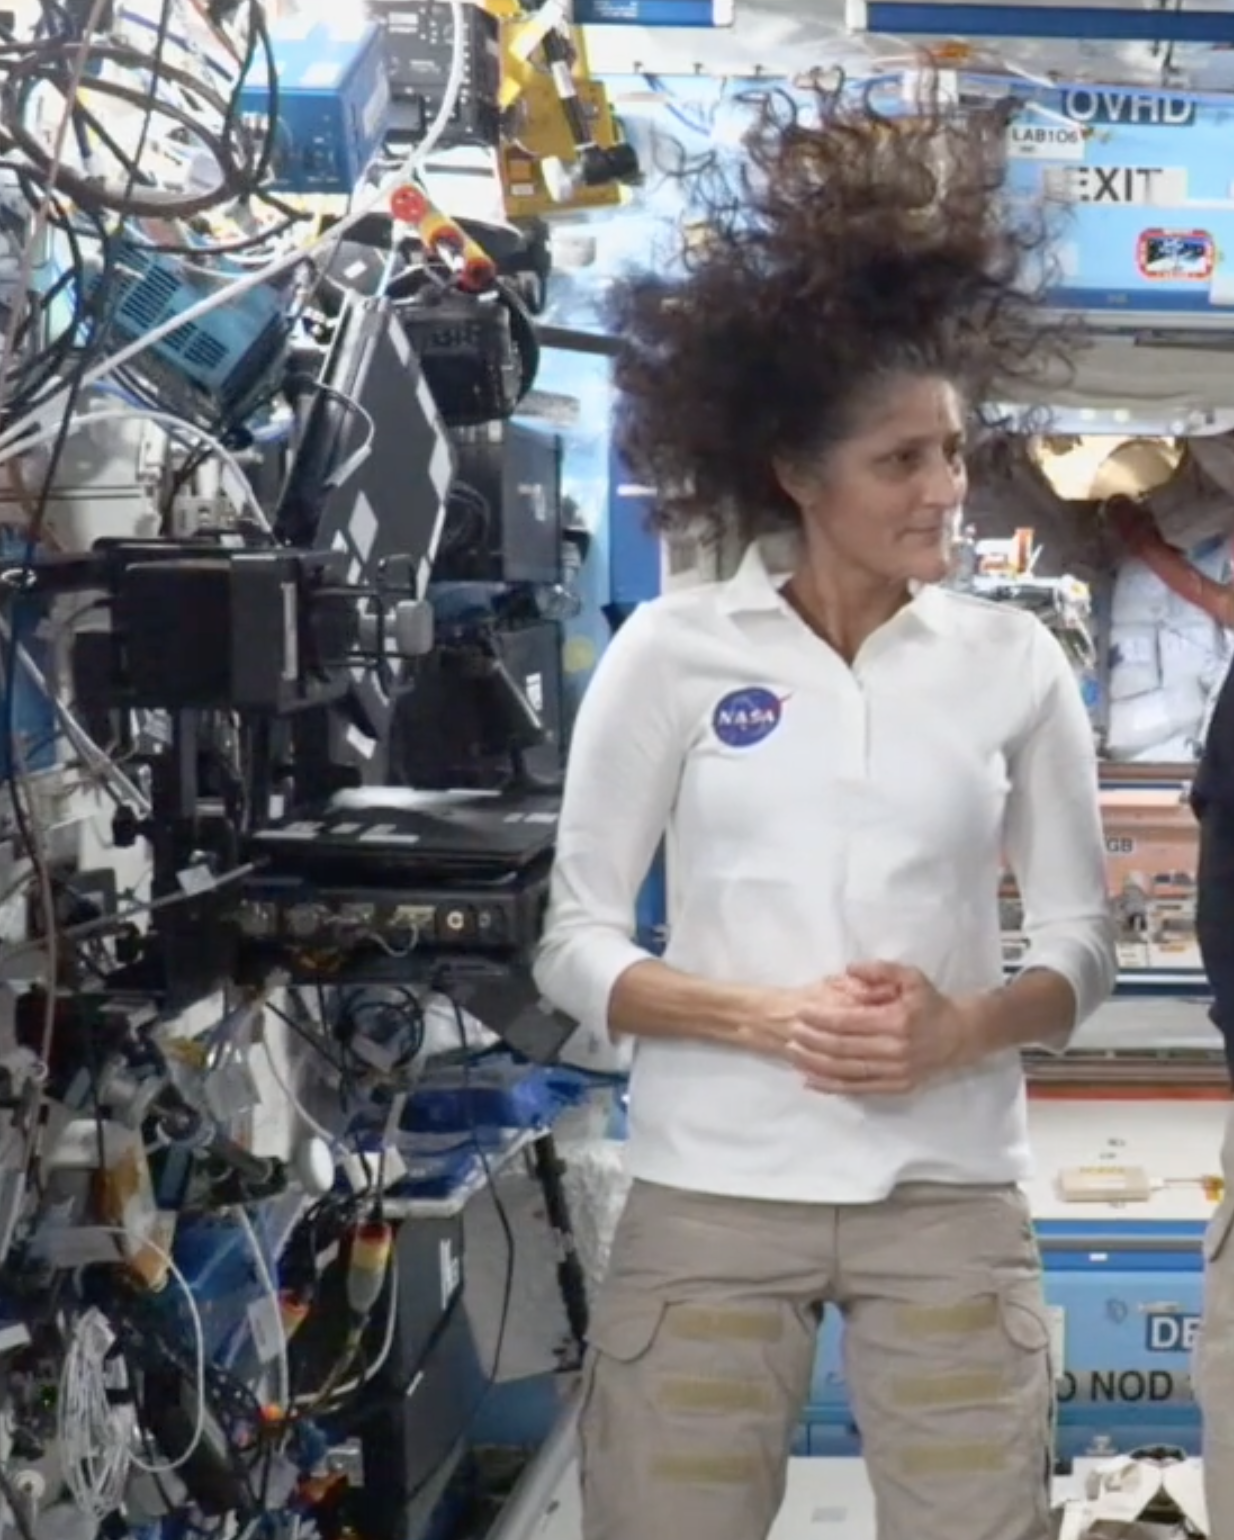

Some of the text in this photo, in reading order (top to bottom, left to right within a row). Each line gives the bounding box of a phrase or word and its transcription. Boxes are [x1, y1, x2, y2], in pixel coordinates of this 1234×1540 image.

[1066, 90, 1191, 123] OVHD
[1066, 166, 1163, 202] EXIT
[719, 708, 776, 728] NASA
[1091, 1371, 1174, 1402] NOD
